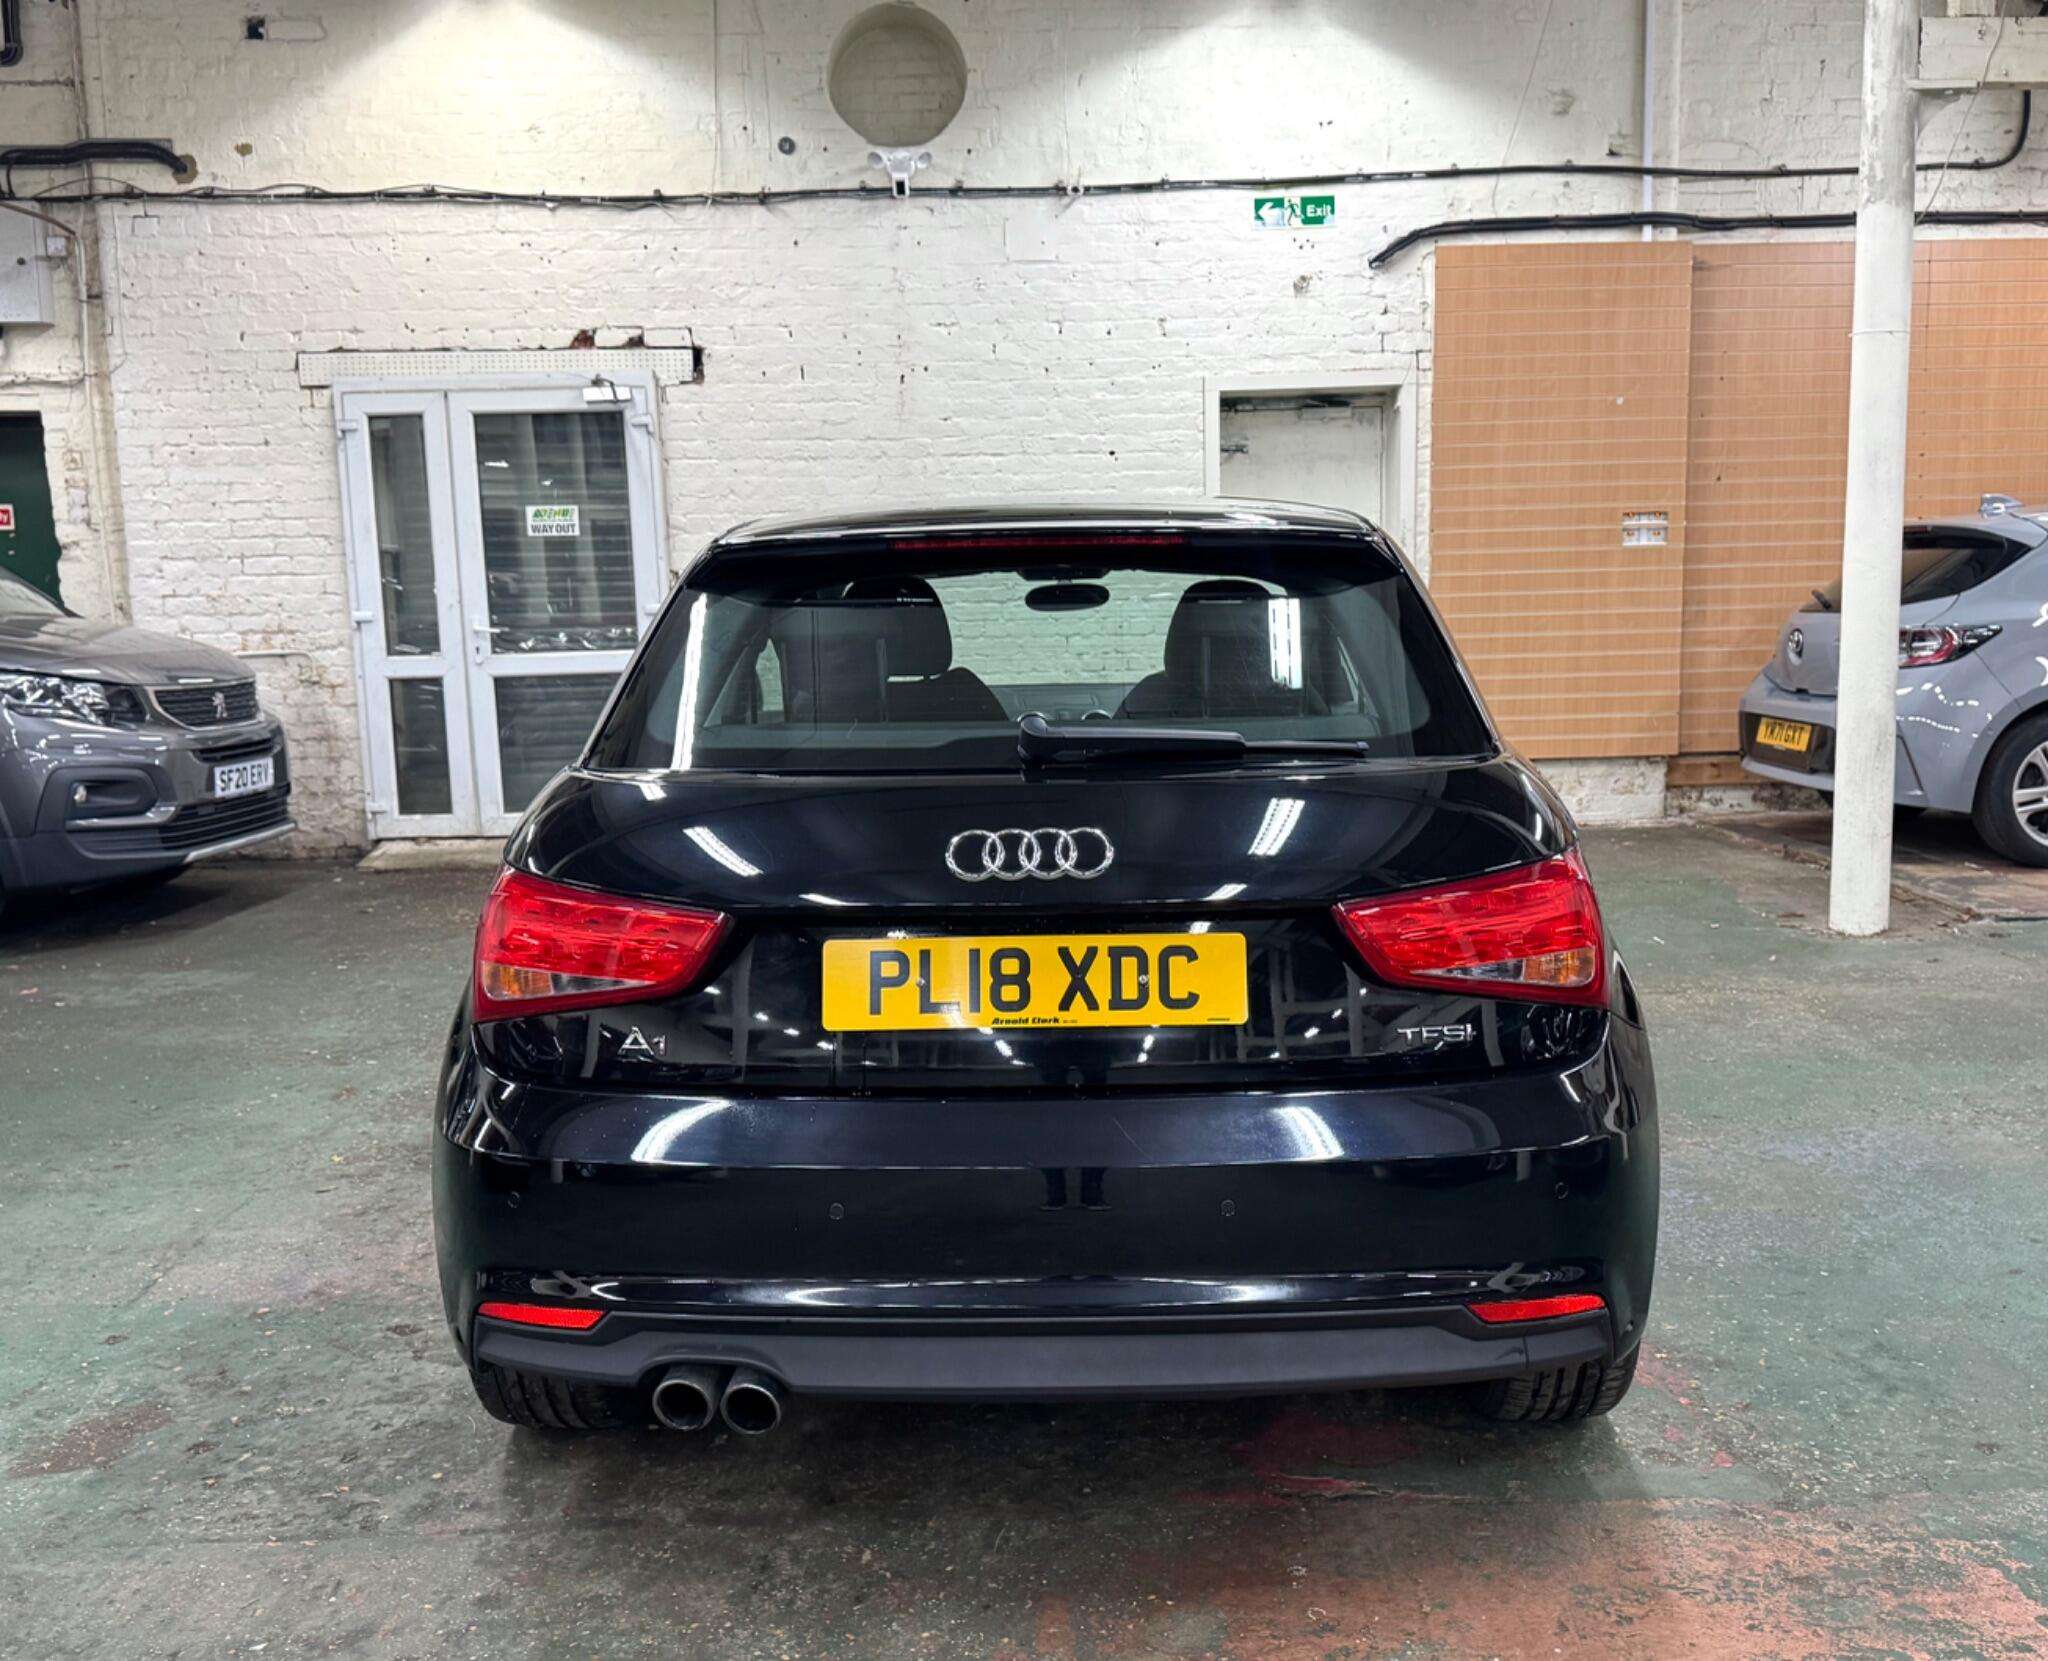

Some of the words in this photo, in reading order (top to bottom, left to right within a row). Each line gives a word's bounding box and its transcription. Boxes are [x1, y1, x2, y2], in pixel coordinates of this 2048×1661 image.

[1306, 203, 1332, 217] Exit
[531, 523, 554, 534] WAY
[555, 523, 576, 533] OUT
[220, 766, 249, 792] SF20
[869, 947, 1031, 1015] PL18
[1057, 945, 1200, 1012] XDC
